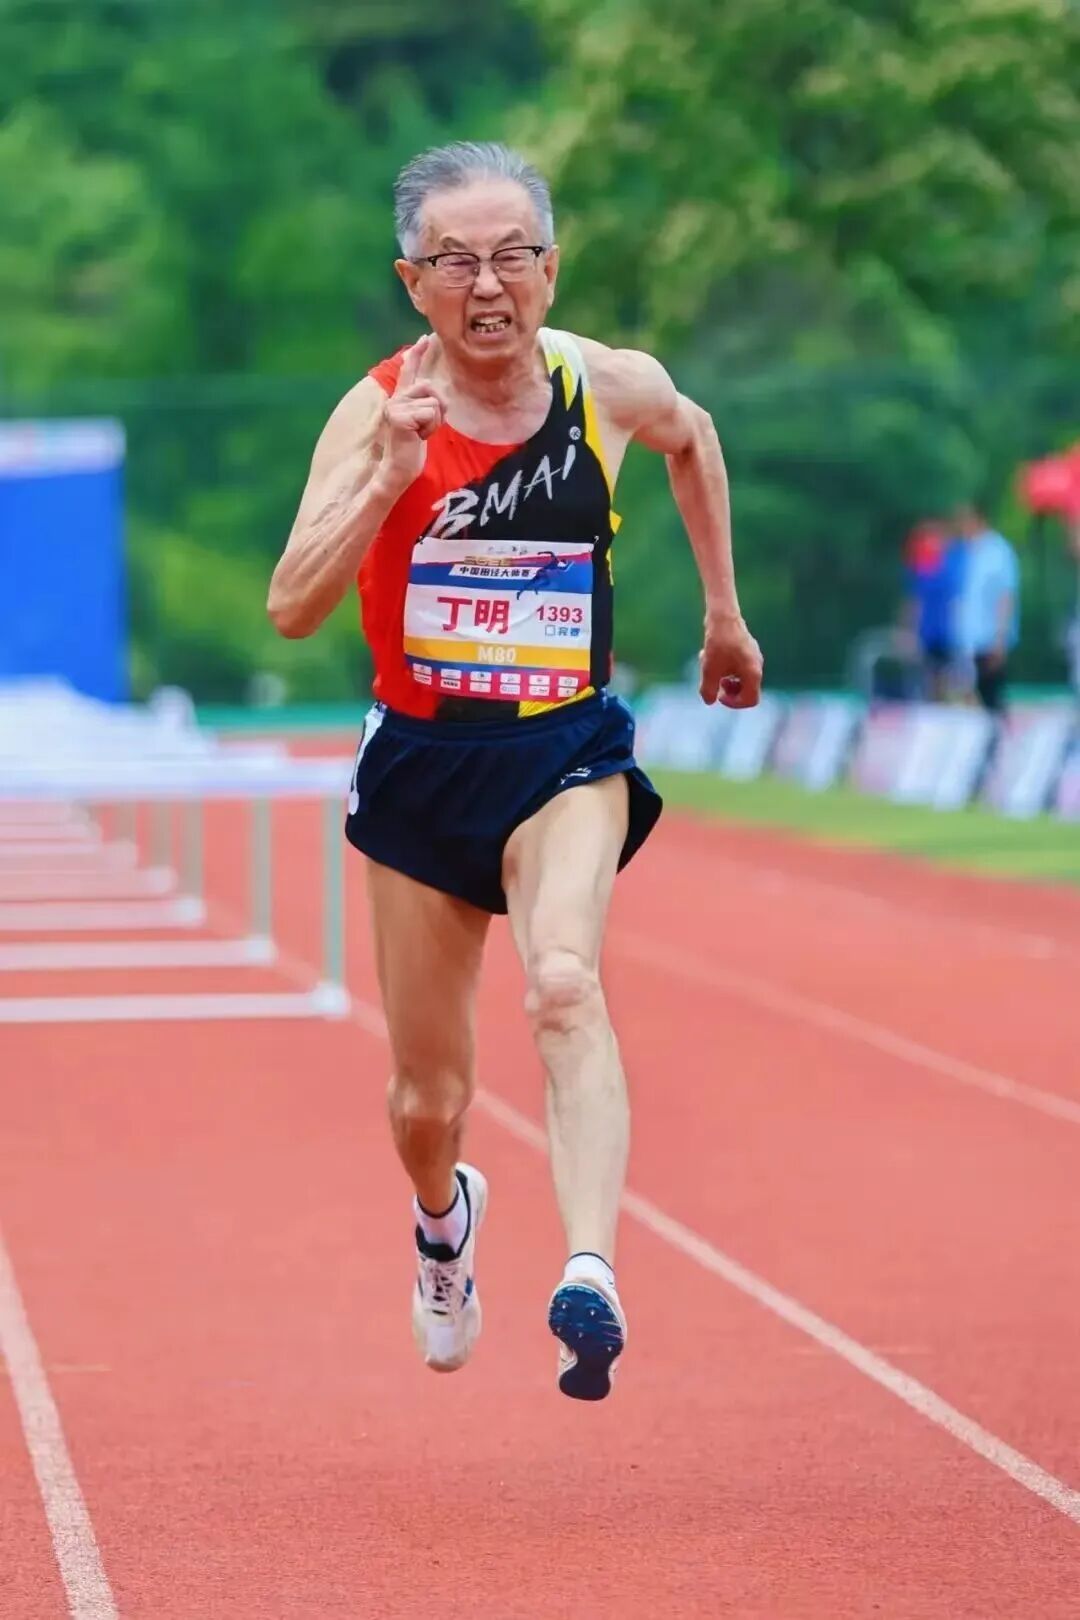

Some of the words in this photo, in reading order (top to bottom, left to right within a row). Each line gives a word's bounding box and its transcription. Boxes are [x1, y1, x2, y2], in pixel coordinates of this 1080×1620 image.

[459, 566, 530, 578] 中国田径大师赛
[437, 596, 510, 635] 丁明
[536, 605, 583, 624] 1393
[477, 644, 517, 664] M80
